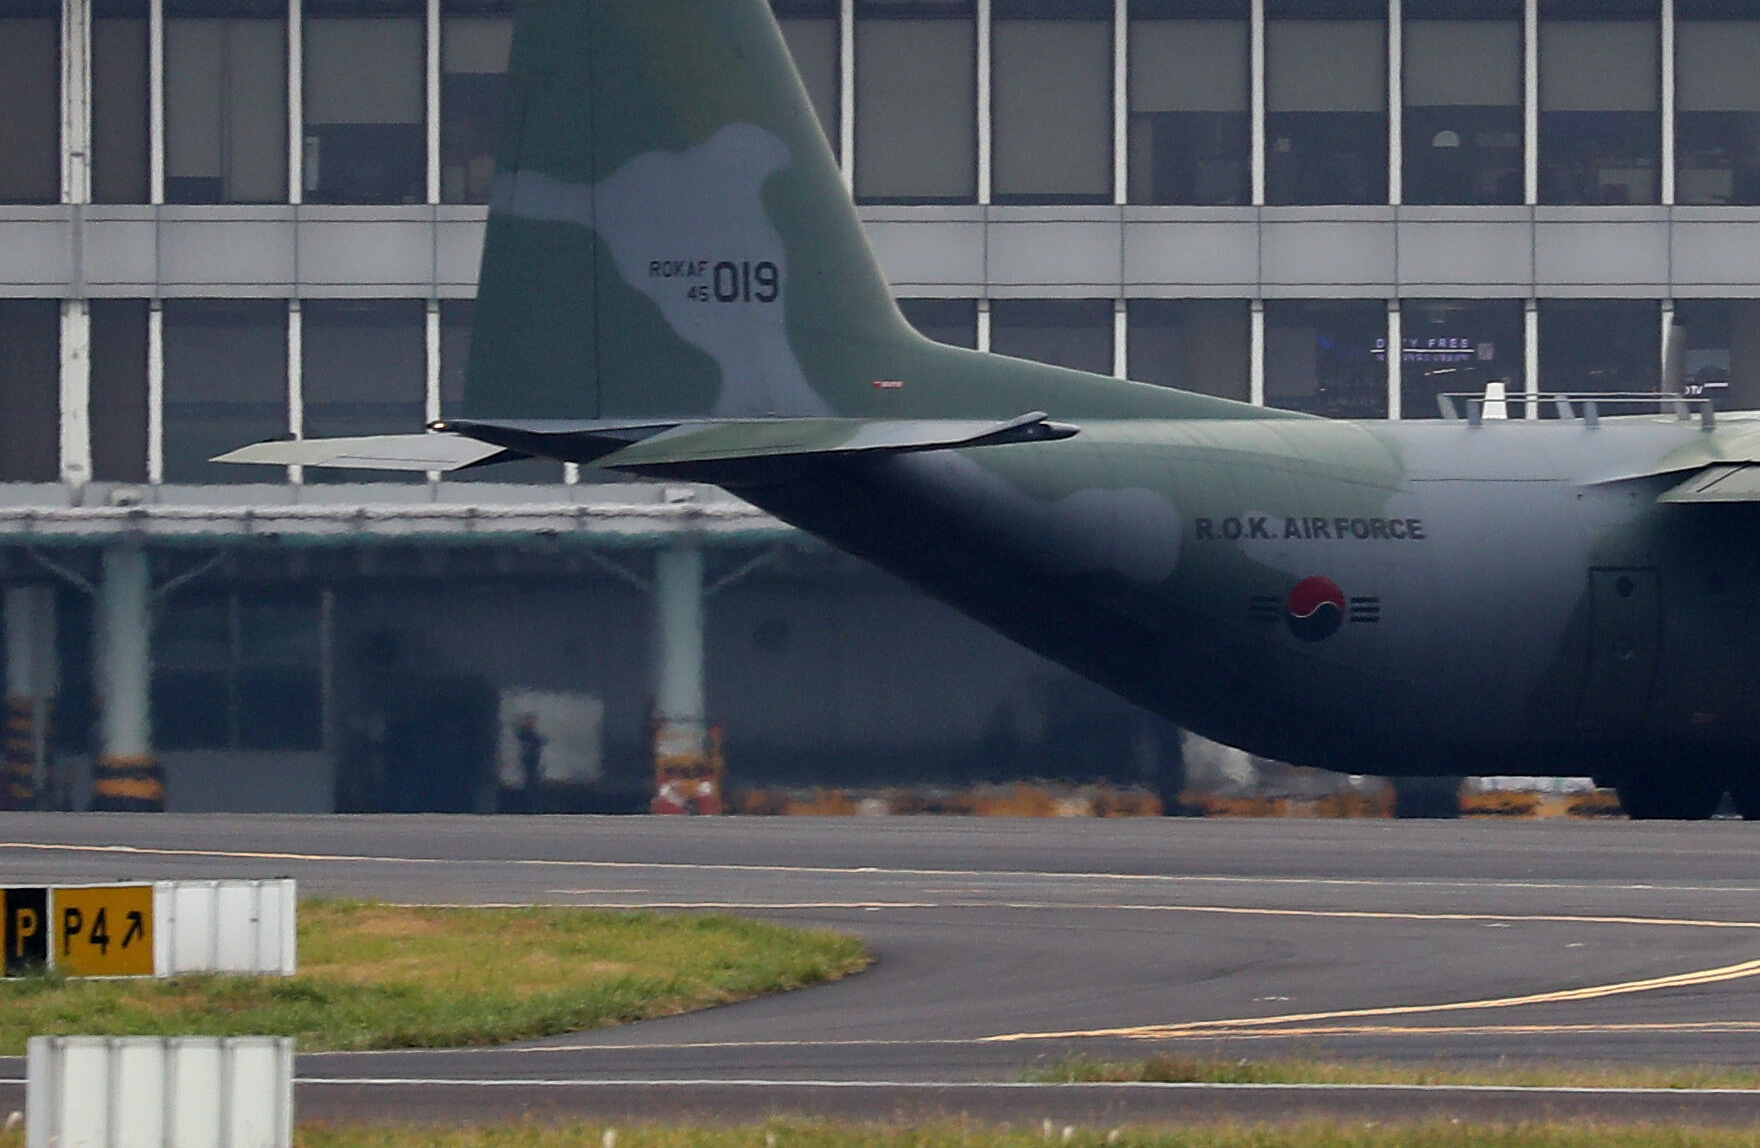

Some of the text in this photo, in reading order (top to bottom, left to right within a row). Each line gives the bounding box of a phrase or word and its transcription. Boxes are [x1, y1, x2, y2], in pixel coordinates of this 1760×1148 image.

[649, 260, 707, 278] ROKAF
[713, 261, 780, 303] 019
[1376, 338, 1470, 348] DY FREE
[1195, 516, 1427, 541] R.O.K. AIR FORCE
[16, 906, 111, 956] P P4
